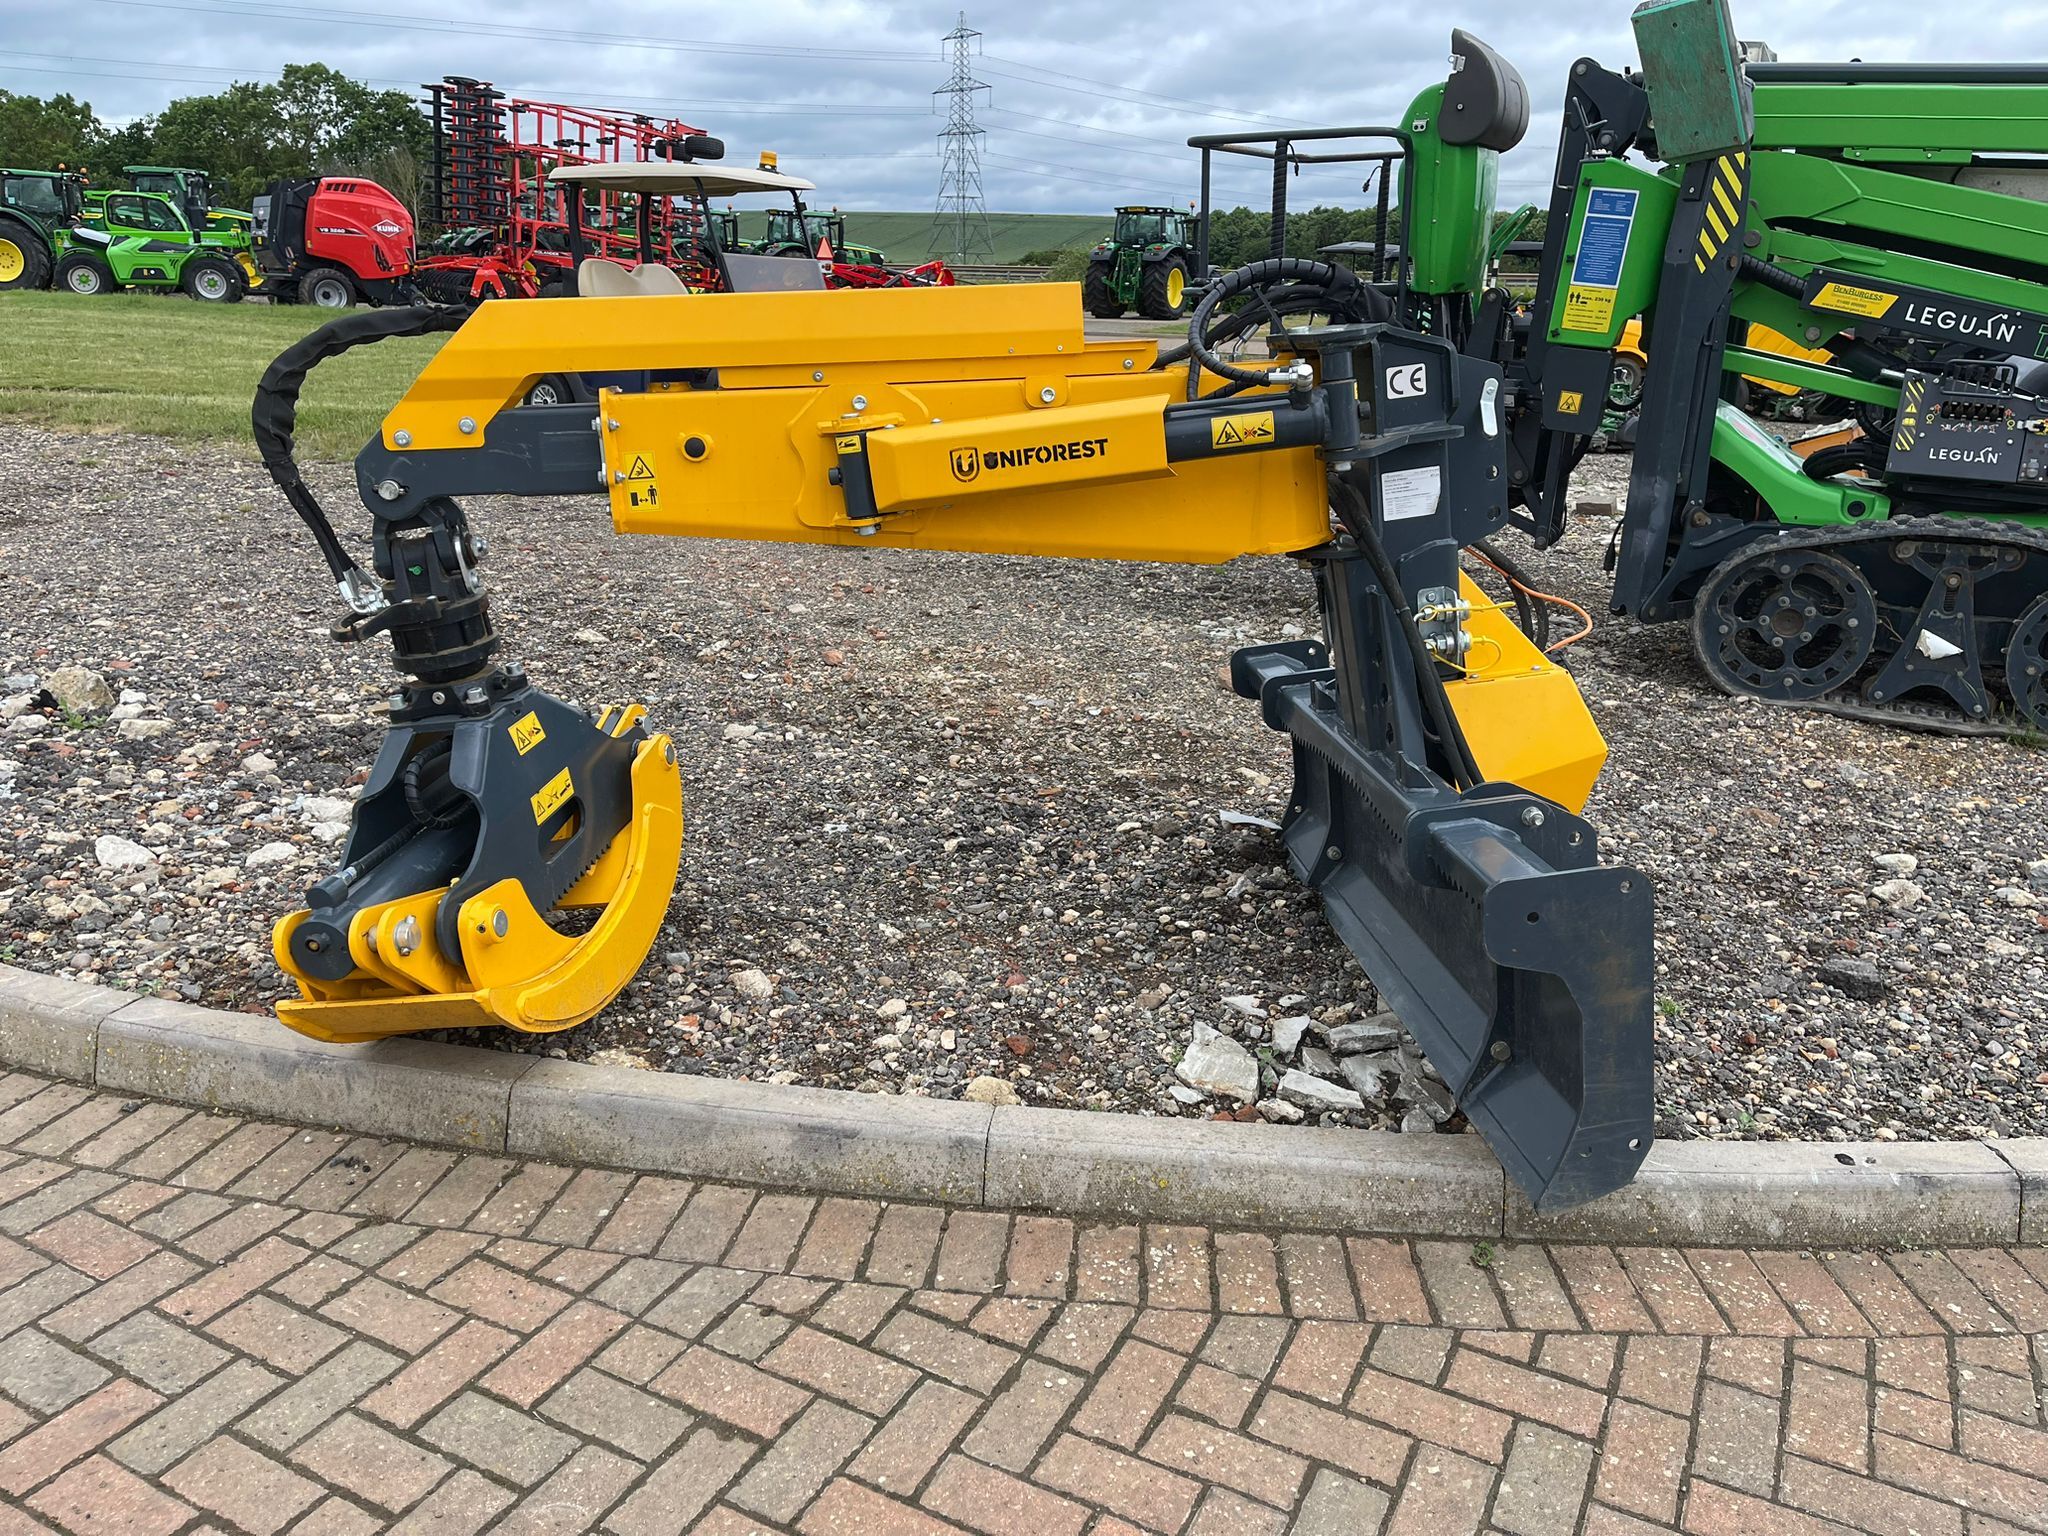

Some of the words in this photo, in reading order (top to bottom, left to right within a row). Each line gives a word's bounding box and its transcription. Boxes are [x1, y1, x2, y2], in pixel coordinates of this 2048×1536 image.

[376, 225, 400, 233] KUHN
[1905, 303, 2016, 342] LEGUAN
[1390, 366, 1424, 396] CE
[983, 438, 1109, 470] UNIFOREST
[1929, 447, 1999, 464] LEGUAN
